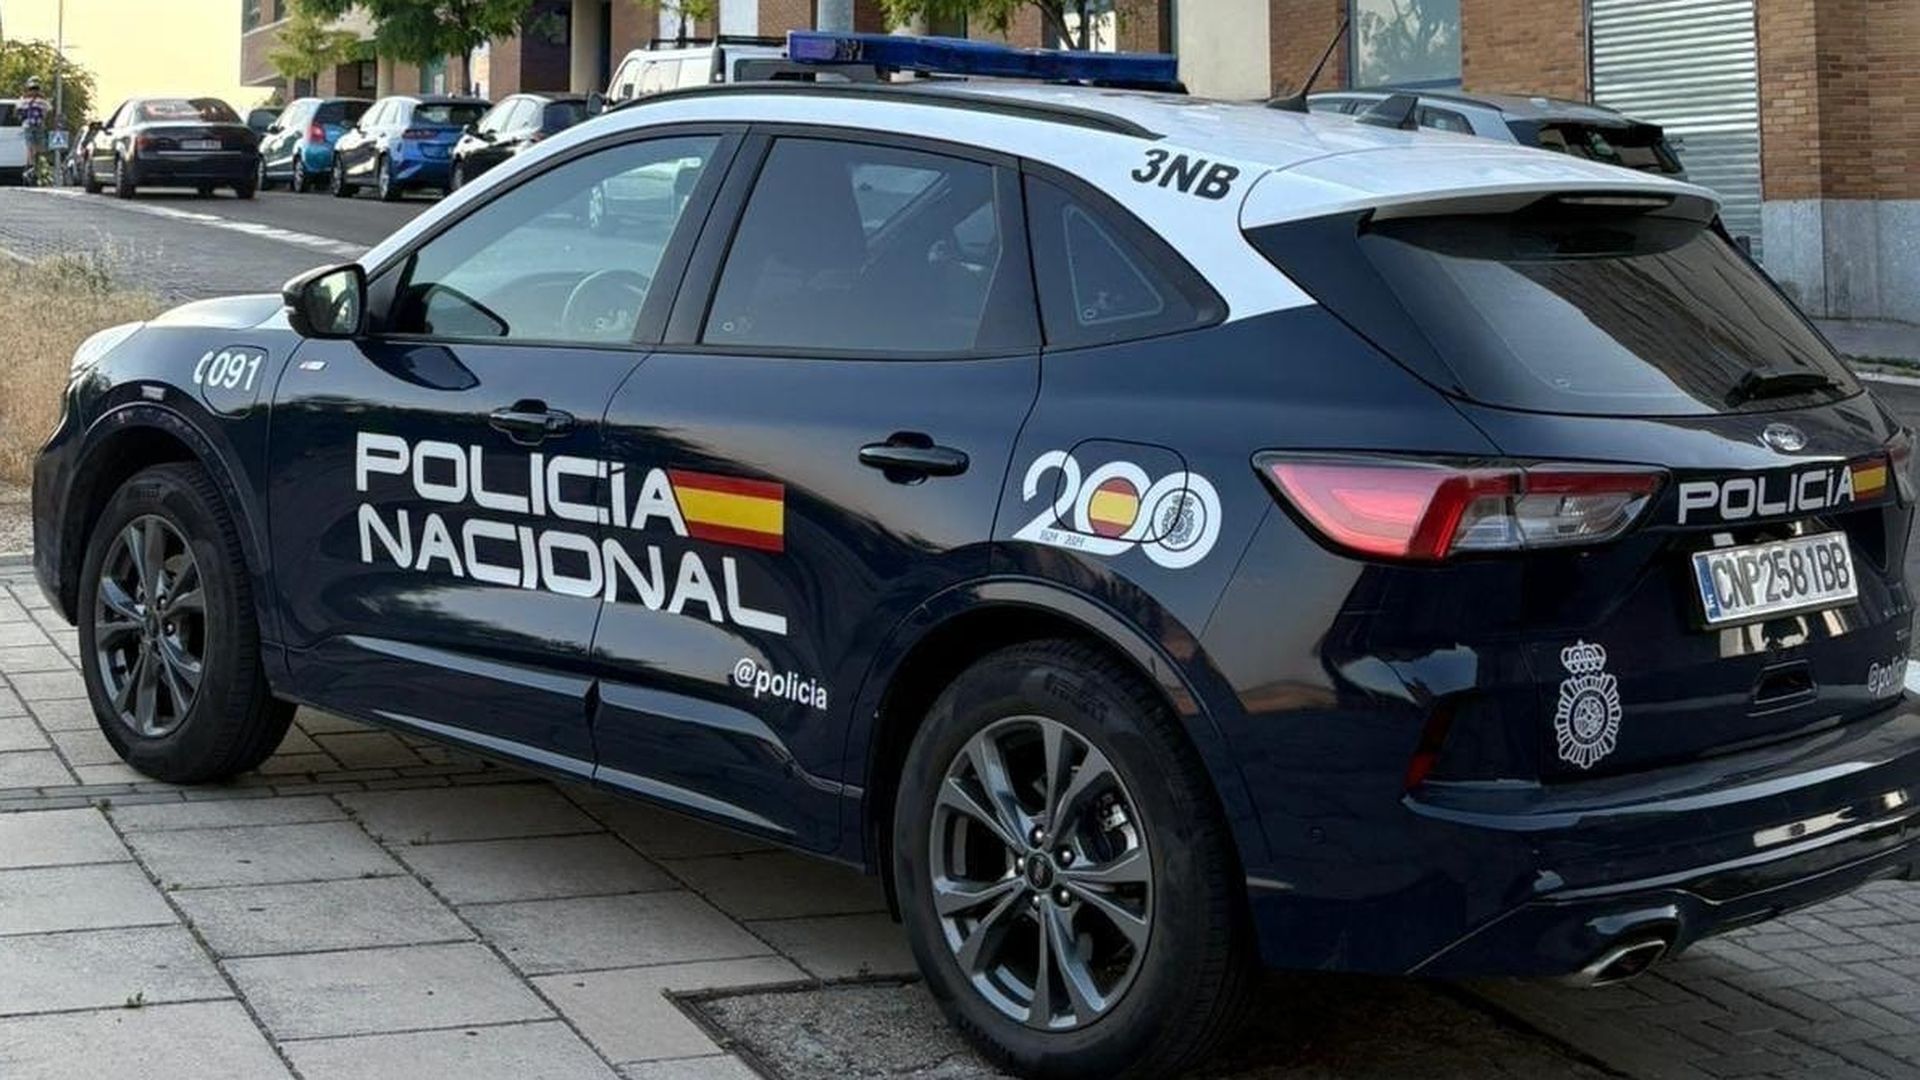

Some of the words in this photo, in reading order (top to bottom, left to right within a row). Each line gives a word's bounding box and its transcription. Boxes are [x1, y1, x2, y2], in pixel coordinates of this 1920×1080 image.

[1131, 149, 1240, 200] 3NB
[207, 352, 263, 391] 091
[1012, 450, 1222, 569] 200
[358, 503, 788, 636] NACIONAL
[1711, 542, 1850, 610] CNP2581BB
[733, 657, 828, 711] @policia
